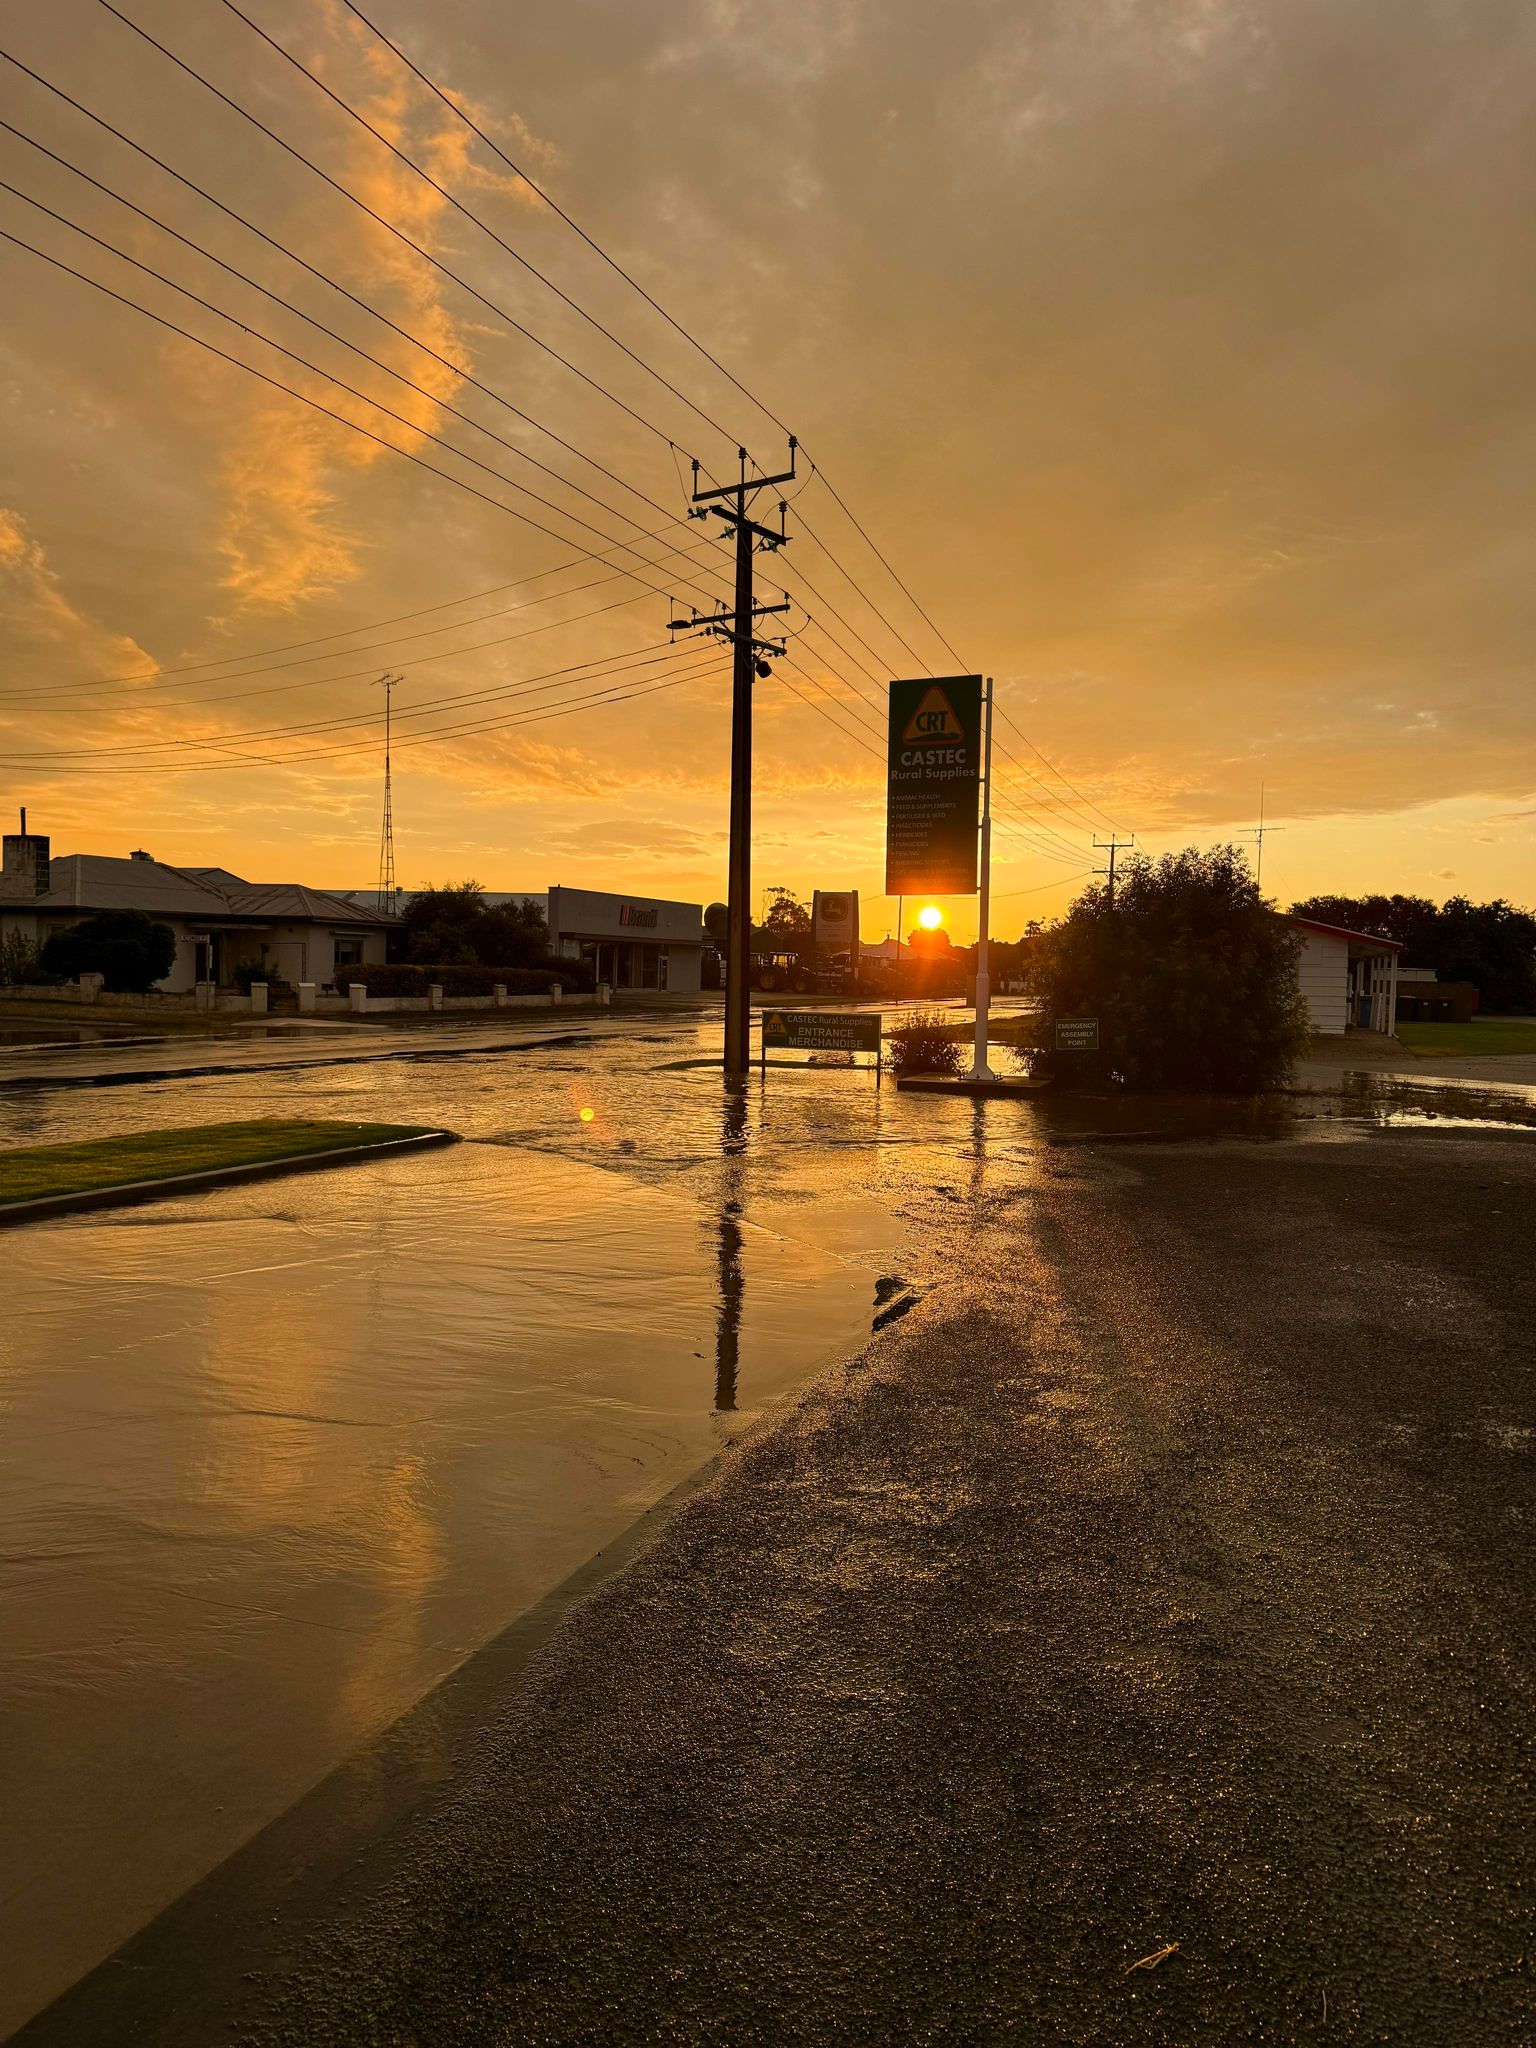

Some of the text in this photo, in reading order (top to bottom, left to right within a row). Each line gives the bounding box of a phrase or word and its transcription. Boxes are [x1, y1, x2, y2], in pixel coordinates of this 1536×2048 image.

[915, 711, 948, 732] CRT
[900, 748, 967, 767] CASTEC
[891, 766, 976, 781] Rural Supplies
[916, 802, 956, 810] SUPPLEMENTS
[787, 1014, 873, 1027] CASTEC Rural Supplies
[1057, 1022, 1097, 1030] EMERGENCY
[798, 1027, 855, 1038] ENTRANCE
[788, 1037, 864, 1049] MERCHANDISE
